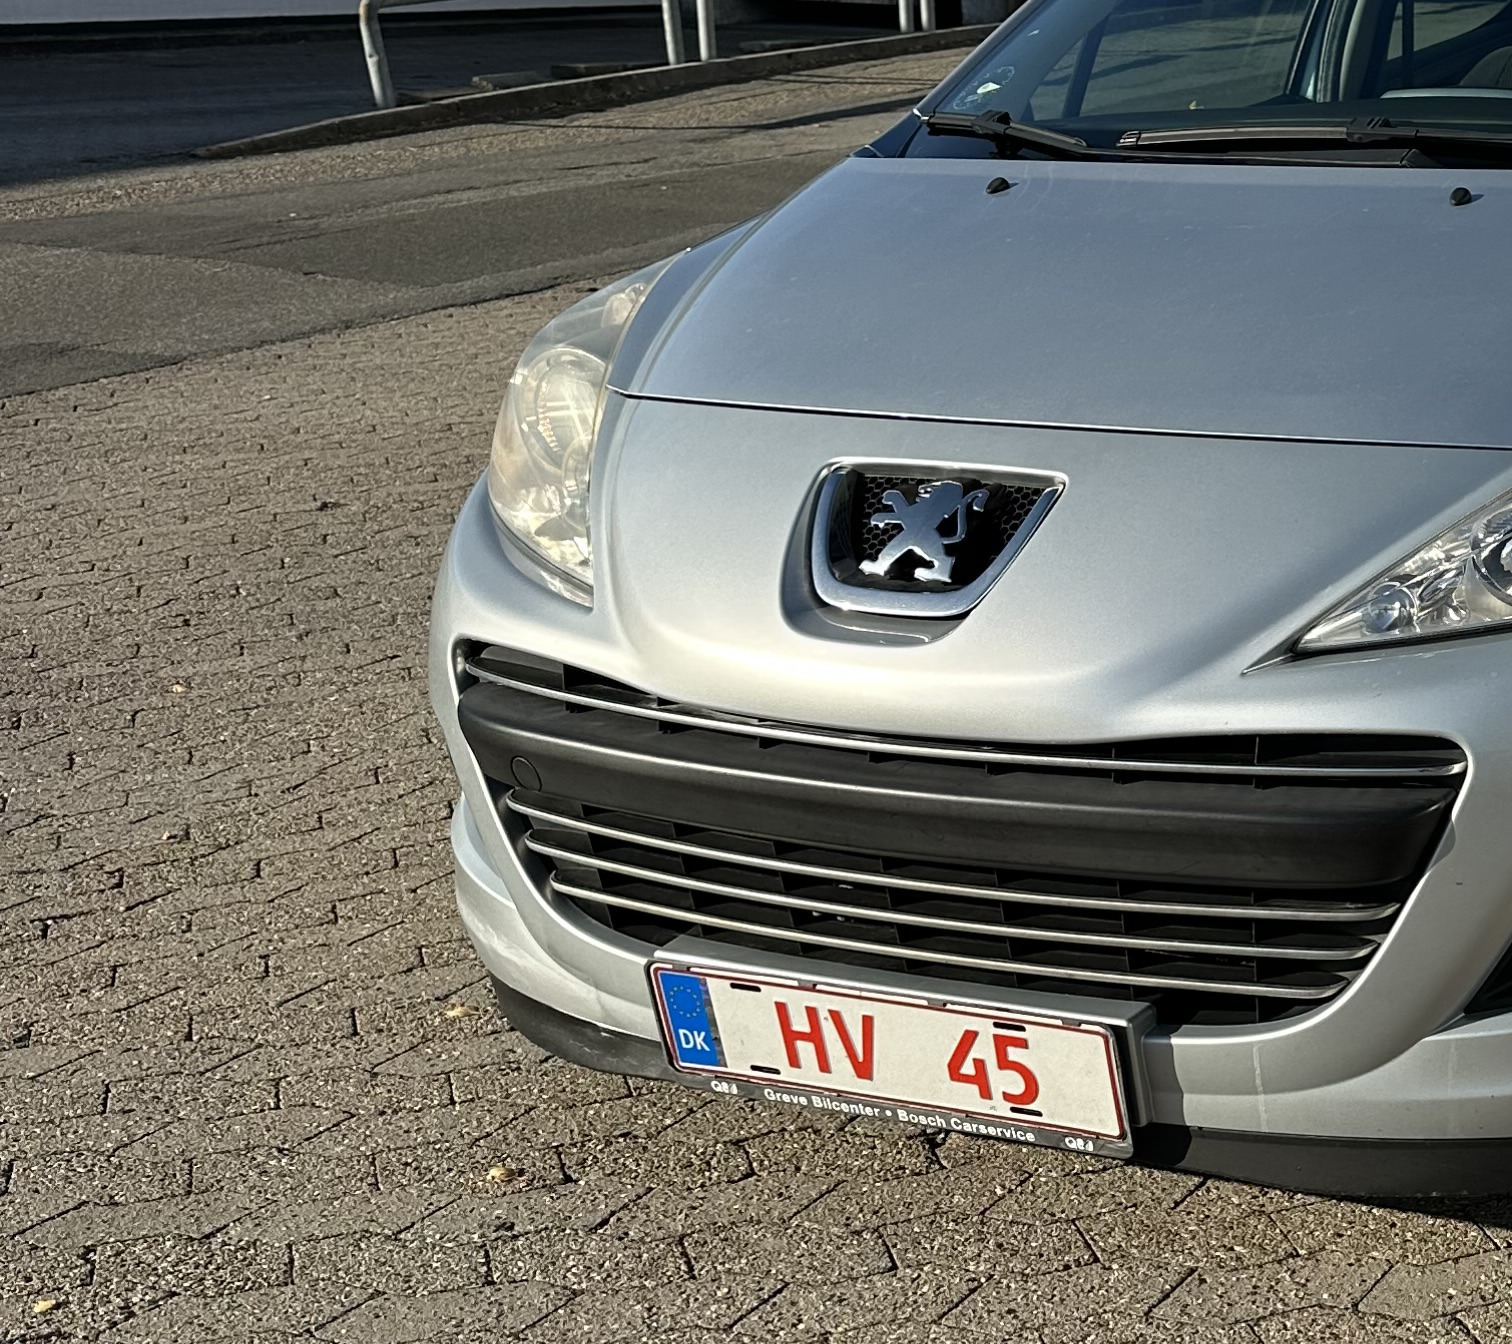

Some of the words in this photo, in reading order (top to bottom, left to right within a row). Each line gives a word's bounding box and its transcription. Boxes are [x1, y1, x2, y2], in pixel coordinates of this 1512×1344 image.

[678, 1028, 711, 1052] DK
[774, 1000, 875, 1081] HV
[947, 1029, 1040, 1106] 45
[763, 1088, 808, 1106] Greve
[811, 1095, 881, 1117] Bilcenter
[896, 1108, 947, 1128] Bosch
[950, 1117, 1036, 1142] Carservice
